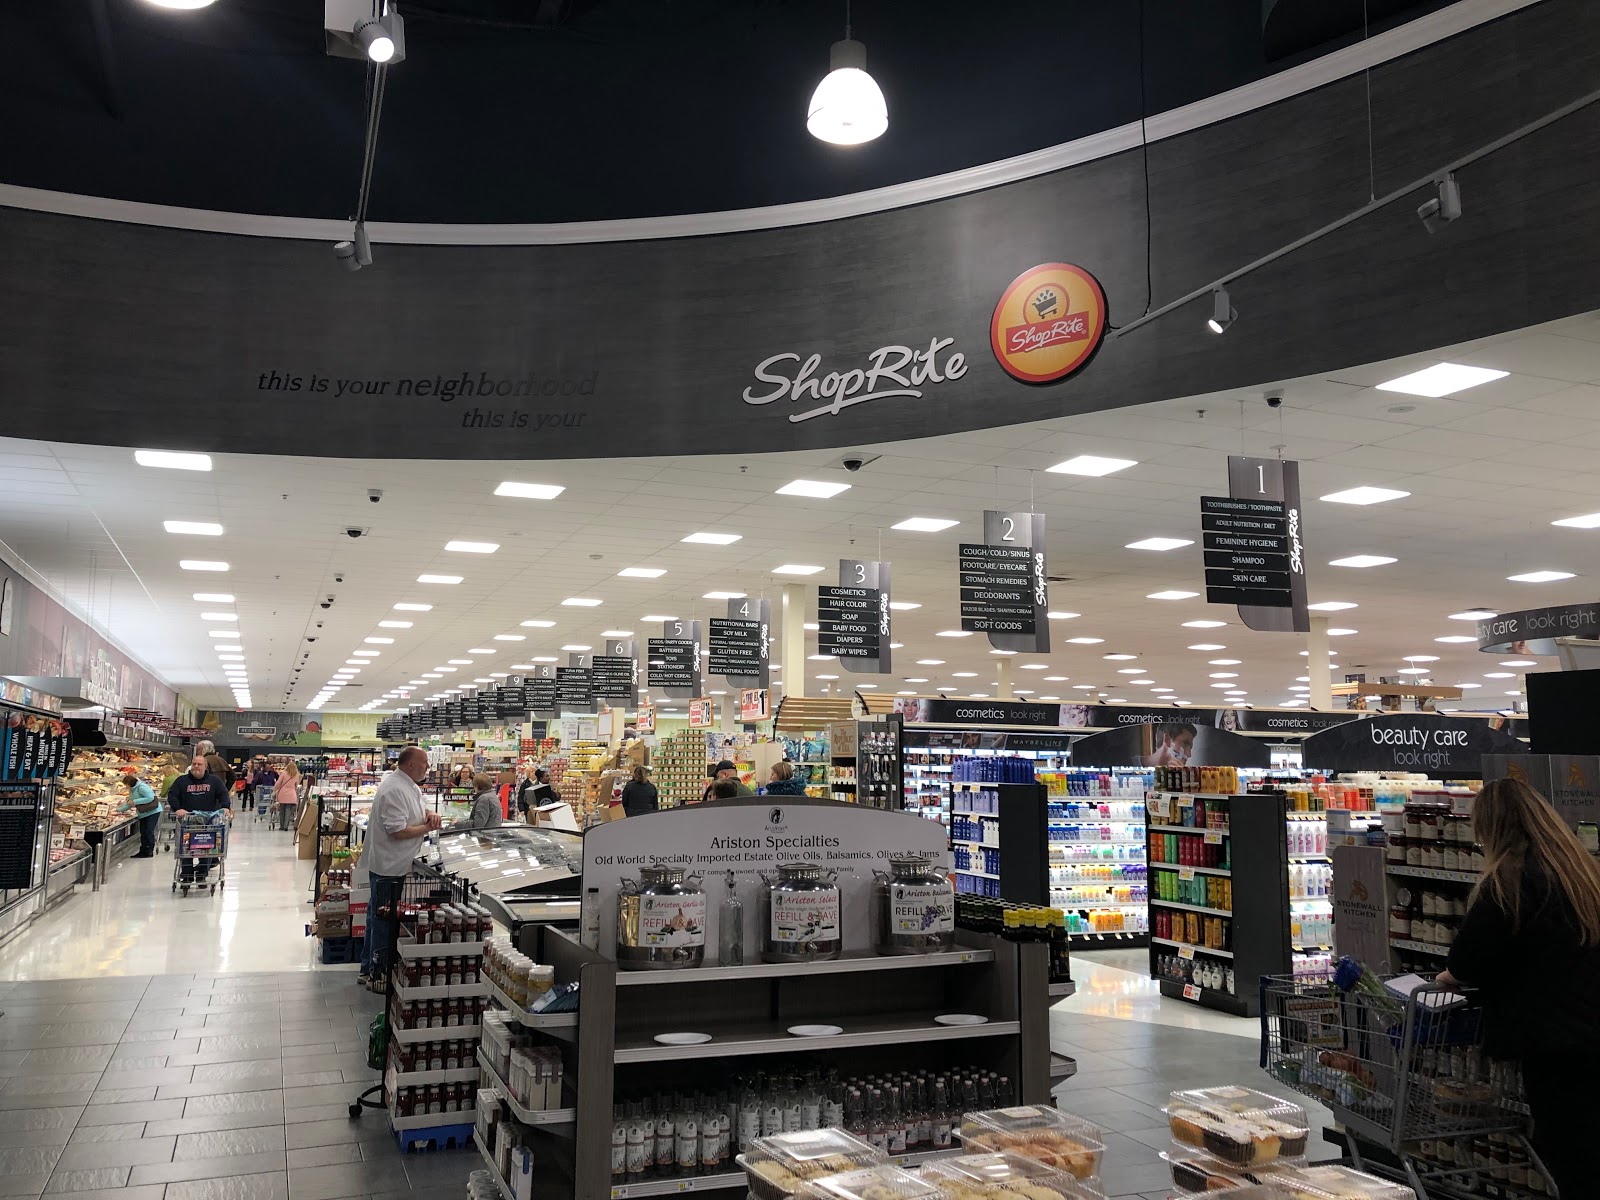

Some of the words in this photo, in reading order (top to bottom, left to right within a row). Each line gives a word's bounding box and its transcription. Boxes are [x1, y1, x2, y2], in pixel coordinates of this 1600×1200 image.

[1010, 317, 1086, 353] ShopRite
[742, 337, 968, 422] ShopRite
[258, 371, 303, 392] this
[309, 374, 329, 392] is
[335, 377, 389, 398] your
[395, 370, 599, 402] neighborhood
[461, 408, 504, 428] this
[508, 409, 529, 428] is
[534, 411, 587, 432] your
[1257, 465, 1266, 494] 1
[1250, 504, 1283, 512] TOOTHPASTE
[1002, 517, 1015, 541] 2
[1233, 520, 1260, 529] NUTRITION
[1216, 537, 1248, 546] FEMININE
[1249, 539, 1278, 548] HYGIENE
[1288, 508, 1304, 575] ShopRite
[963, 548, 1030, 558] COUGH/COLD/SINUS
[1232, 556, 1265, 565] SHAMPOO
[855, 564, 866, 584] 3
[1035, 552, 1047, 607] ShopRite
[1232, 574, 1248, 582] SKIN
[1250, 575, 1267, 583] CARE
[965, 576, 995, 584] STOMACH
[996, 577, 1028, 585] REMEDIES
[831, 588, 866, 596] COSMETICS
[974, 591, 1020, 600] DEODORANTS
[740, 602, 749, 617] 4
[881, 593, 891, 637] ShopRite
[974, 621, 993, 629] SOFT
[995, 621, 1022, 630] GOODS
[1492, 619, 1518, 635] care
[1525, 613, 1555, 629] look
[1560, 610, 1596, 629] right
[674, 622, 682, 636] 5
[836, 636, 863, 644] DIAPERS
[615, 642, 623, 654] 6
[849, 648, 868, 656] WIPES
[578, 655, 585, 666] 7
[542, 667, 549, 677] 8
[513, 676, 520, 686] 9
[956, 708, 1005, 719] cosmetics
[1010, 709, 1028, 719] look
[1029, 710, 1046, 721] right
[1118, 713, 1163, 723] cosmetics
[1268, 717, 1308, 728] cosmetics
[1312, 719, 1327, 728] look
[1371, 723, 1429, 750] beauty
[1433, 727, 1468, 746] care
[10, 732, 19, 755] WHOLE
[1013, 739, 1063, 747] MAYBELLINE
[60, 738, 68, 763] SPECIALTY
[9, 755, 17, 770] FISH
[1393, 748, 1422, 765] look
[1423, 749, 1450, 769] right
[711, 836, 761, 849] Ariston
[766, 835, 840, 850] Specialties
[595, 855, 613, 865] Old
[617, 855, 646, 865] World
[649, 854, 694, 865] Specialty
[696, 852, 741, 864] Imported
[744, 853, 774, 862] Estate
[776, 851, 800, 861] Olive
[803, 851, 823, 861] Oils,
[826, 851, 874, 860] Balsamics,
[876, 850, 904, 859] Olives
[785, 895, 817, 905] Ariston
[818, 894, 838, 904] Select
[895, 906, 925, 916] REFILL
[1337, 900, 1383, 912] STONEWALL
[774, 911, 804, 922] REFILL
[807, 911, 815, 922] &
[816, 910, 837, 922] SAVE
[1343, 909, 1376, 919] KITCHEN
[677, 918, 685, 928] &
